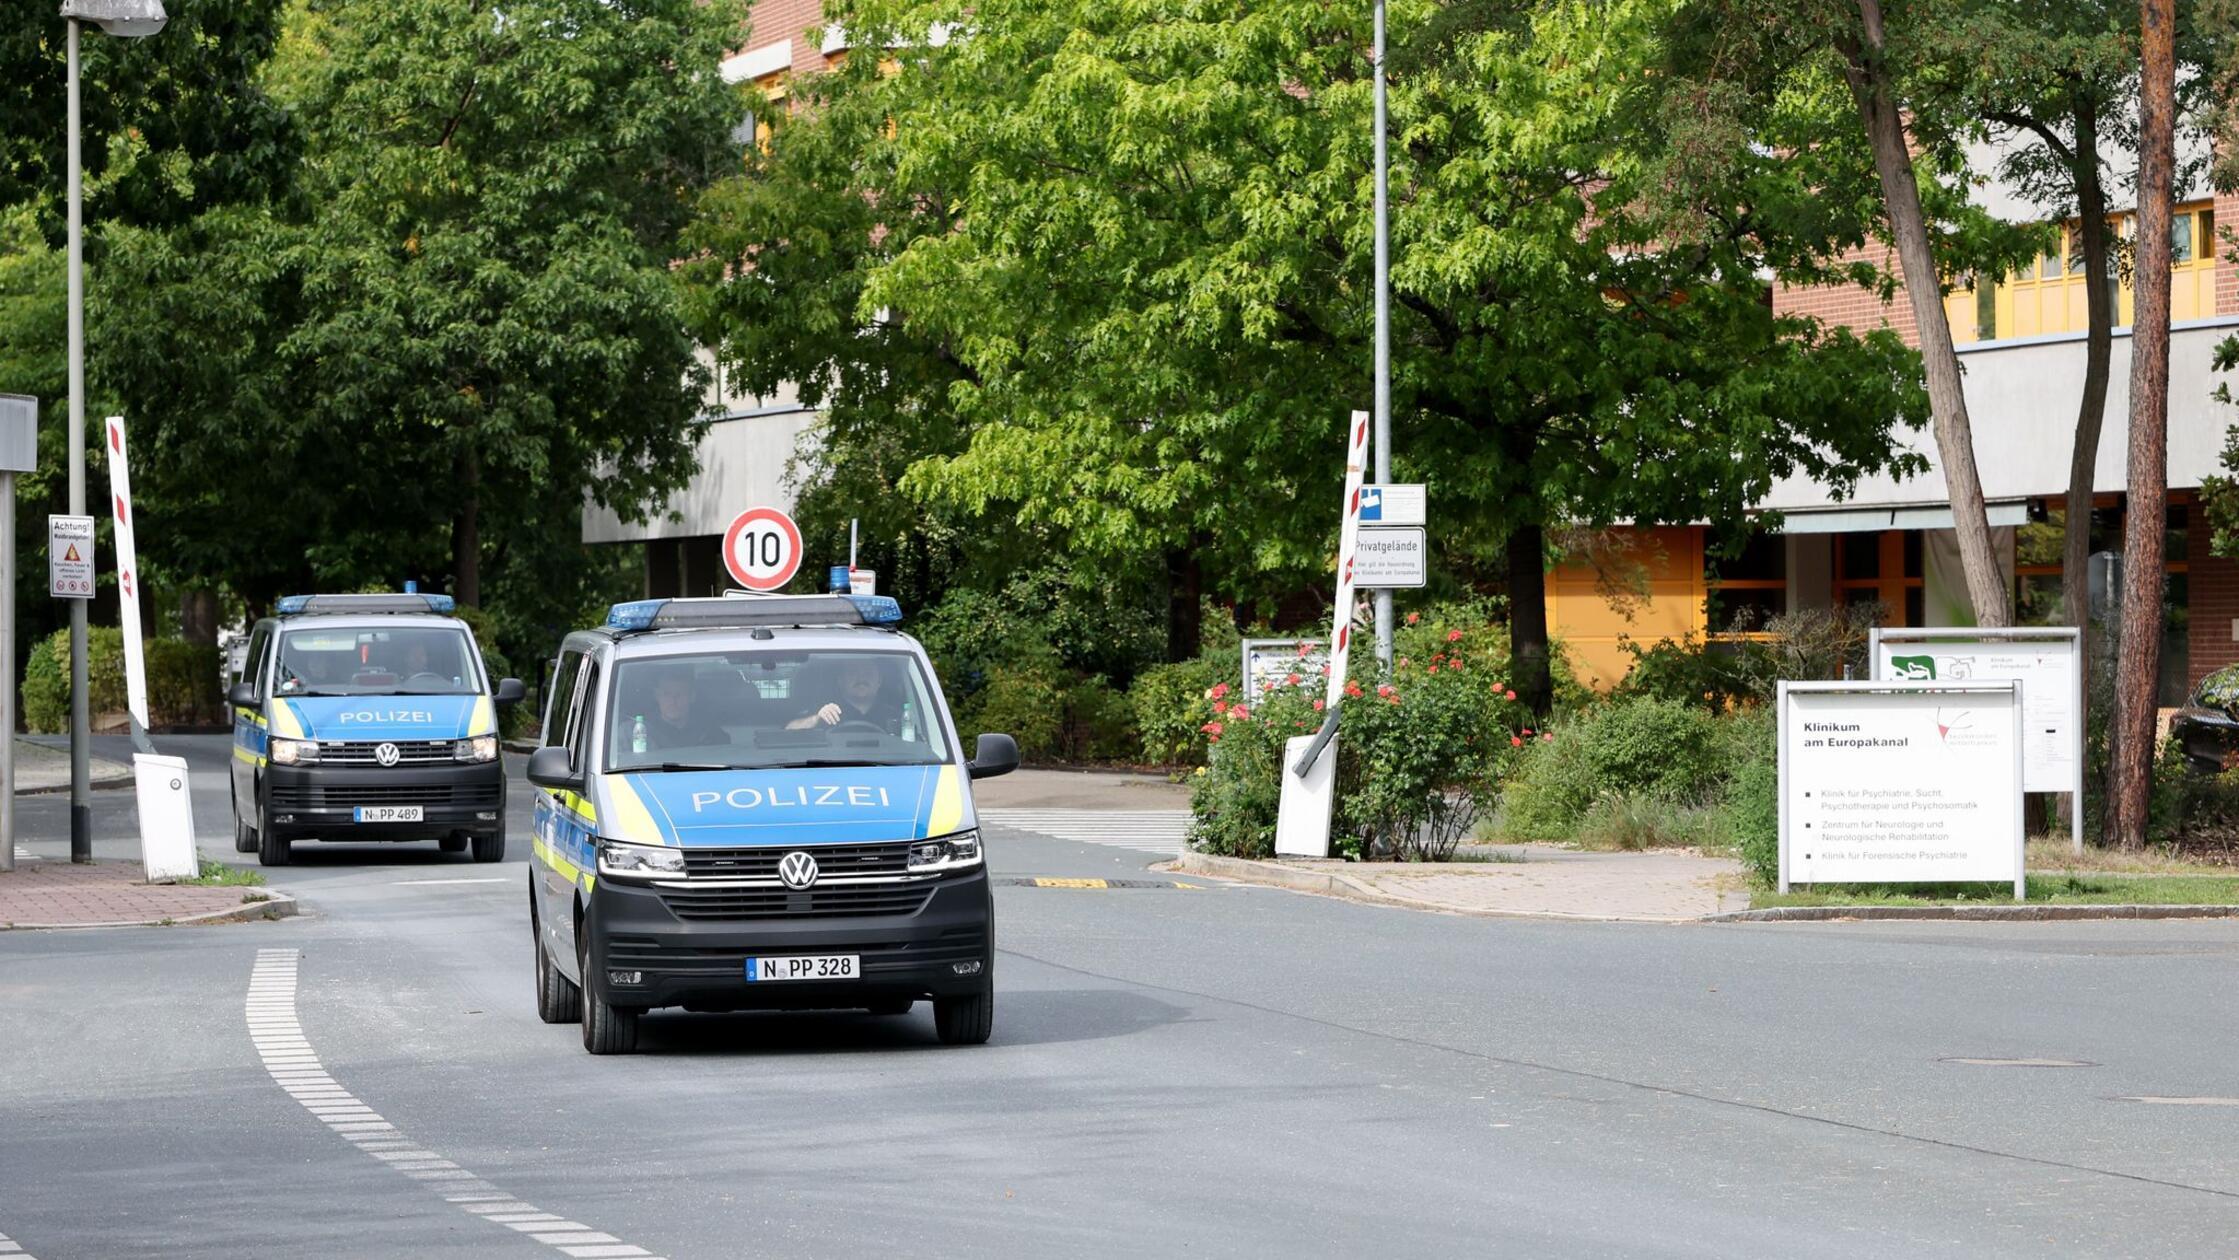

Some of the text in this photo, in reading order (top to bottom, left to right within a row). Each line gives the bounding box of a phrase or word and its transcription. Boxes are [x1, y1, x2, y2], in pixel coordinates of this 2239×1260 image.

[54, 521, 89, 532] Achtung!
[745, 532, 780, 567] 10
[340, 711, 432, 724] POLIZEI
[1804, 722, 1860, 732] Klinikum
[1804, 737, 1909, 749] am Europakanal
[692, 785, 890, 812] POLIZEI
[1821, 789, 1845, 798] Klinik
[1848, 789, 1860, 798] für
[1821, 800, 1978, 811] Psychotherapie und Psychosomatik
[365, 809, 418, 820] N PP 489
[1821, 820, 1944, 831] Zentrum für Neurologie und
[1821, 832, 1949, 843] Neurologische Rehabilitation
[1821, 851, 1968, 862] Klinik für Forensische Psychiatrie
[764, 960, 776, 978] N
[790, 959, 813, 977] PP
[818, 958, 851, 976] 328
